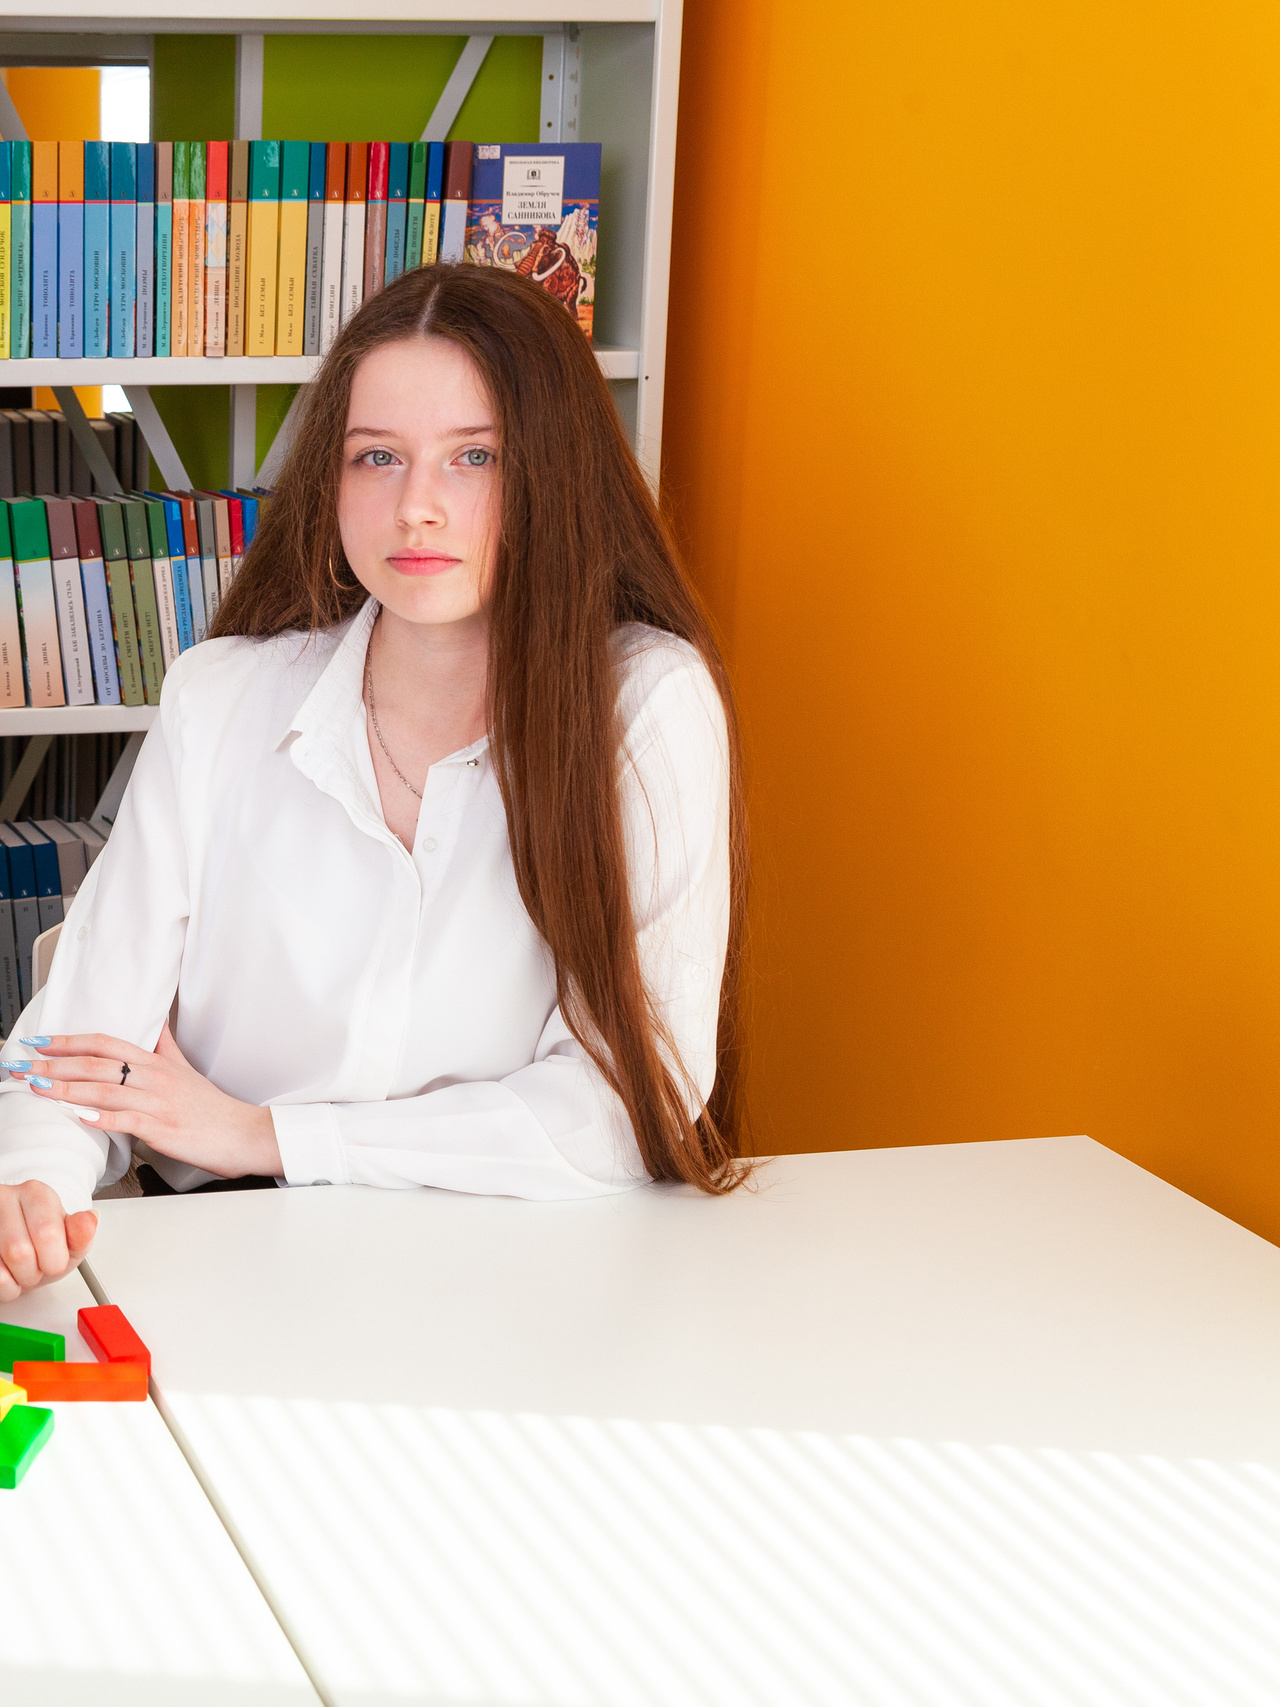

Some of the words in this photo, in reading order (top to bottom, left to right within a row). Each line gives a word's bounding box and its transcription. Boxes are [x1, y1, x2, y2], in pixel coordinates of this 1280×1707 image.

[507, 211, 556, 219] САННИКОВА
[518, 201, 547, 209] ЗЕМЛЯ
[68, 600, 77, 638] ЗАКАЛЯЛАСЬ
[96, 609, 105, 641] БЕРЛИНА
[41, 642, 49, 666] ДИНКА
[100, 643, 107, 653] ДО
[124, 630, 132, 659] СМЕРТИ
[147, 629, 155, 657] СМЕРТИ
[102, 655, 110, 684] МОСКВЫ
[105, 686, 112, 696] ОТ
